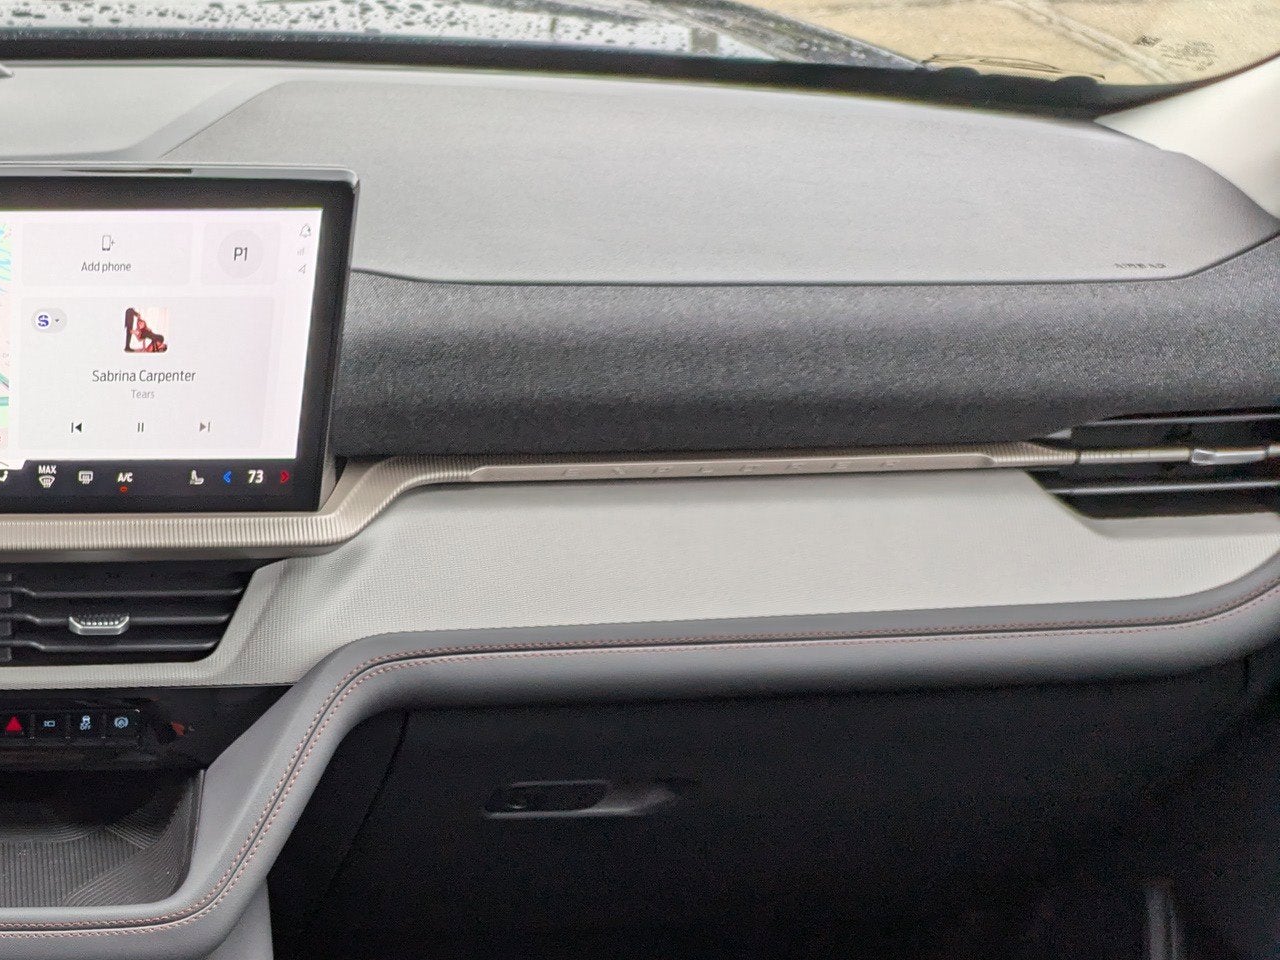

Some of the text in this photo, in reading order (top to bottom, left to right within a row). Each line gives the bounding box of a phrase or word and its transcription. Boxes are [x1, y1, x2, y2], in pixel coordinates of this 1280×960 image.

[233, 246, 249, 262] P1
[81, 262, 132, 274] Add phone
[92, 370, 196, 383] Sabrina Carpenter
[131, 389, 155, 399] Tears
[38, 465, 57, 474] MAX
[117, 472, 133, 483] A/C
[248, 469, 264, 484] 73
